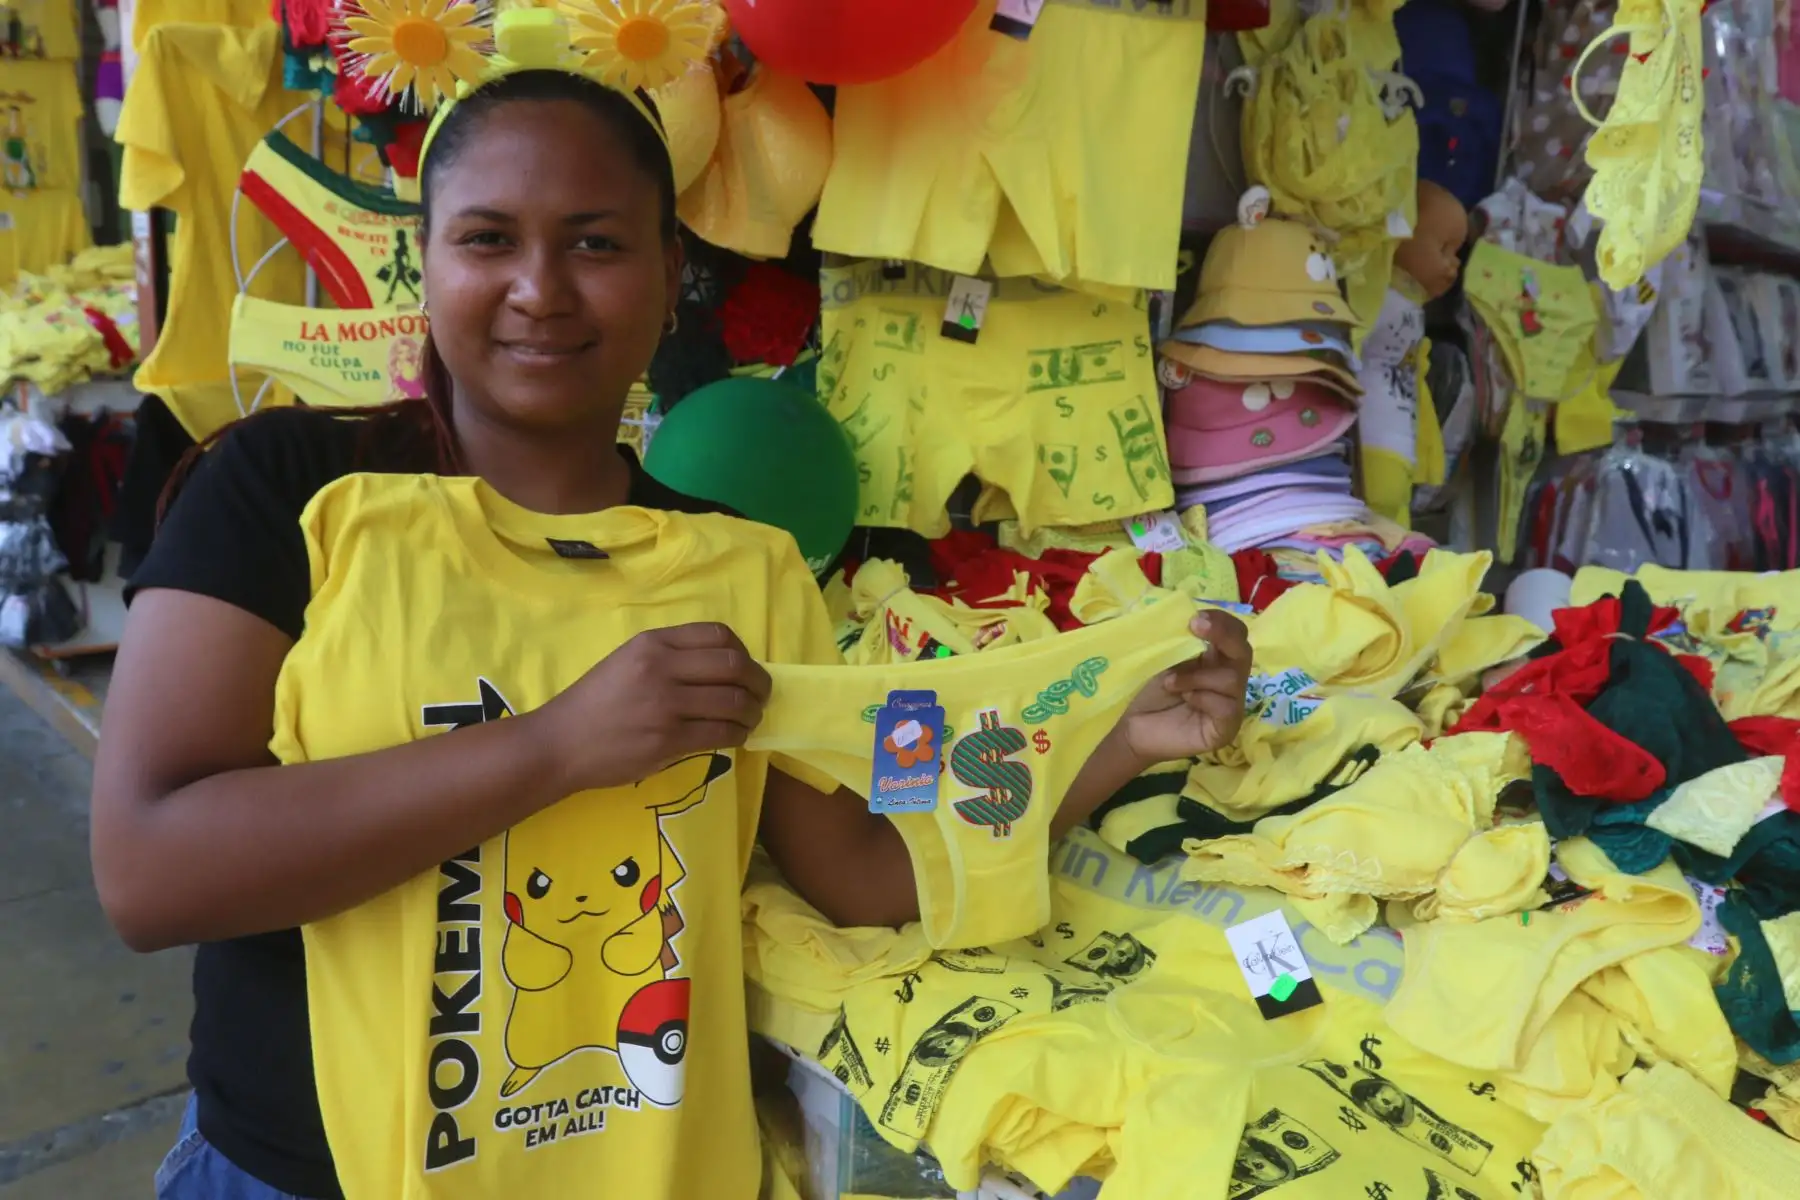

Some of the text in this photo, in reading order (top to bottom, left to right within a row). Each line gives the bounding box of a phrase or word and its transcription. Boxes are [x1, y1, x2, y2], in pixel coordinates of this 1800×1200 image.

[300, 321, 330, 342] LA
[309, 356, 363, 368] CULPA
[341, 369, 381, 381] TUYA
[423, 703, 484, 1171] POKEM
[494, 1085, 640, 1129] GOTTA CATCH
[525, 1110, 604, 1148] EM ALL!
